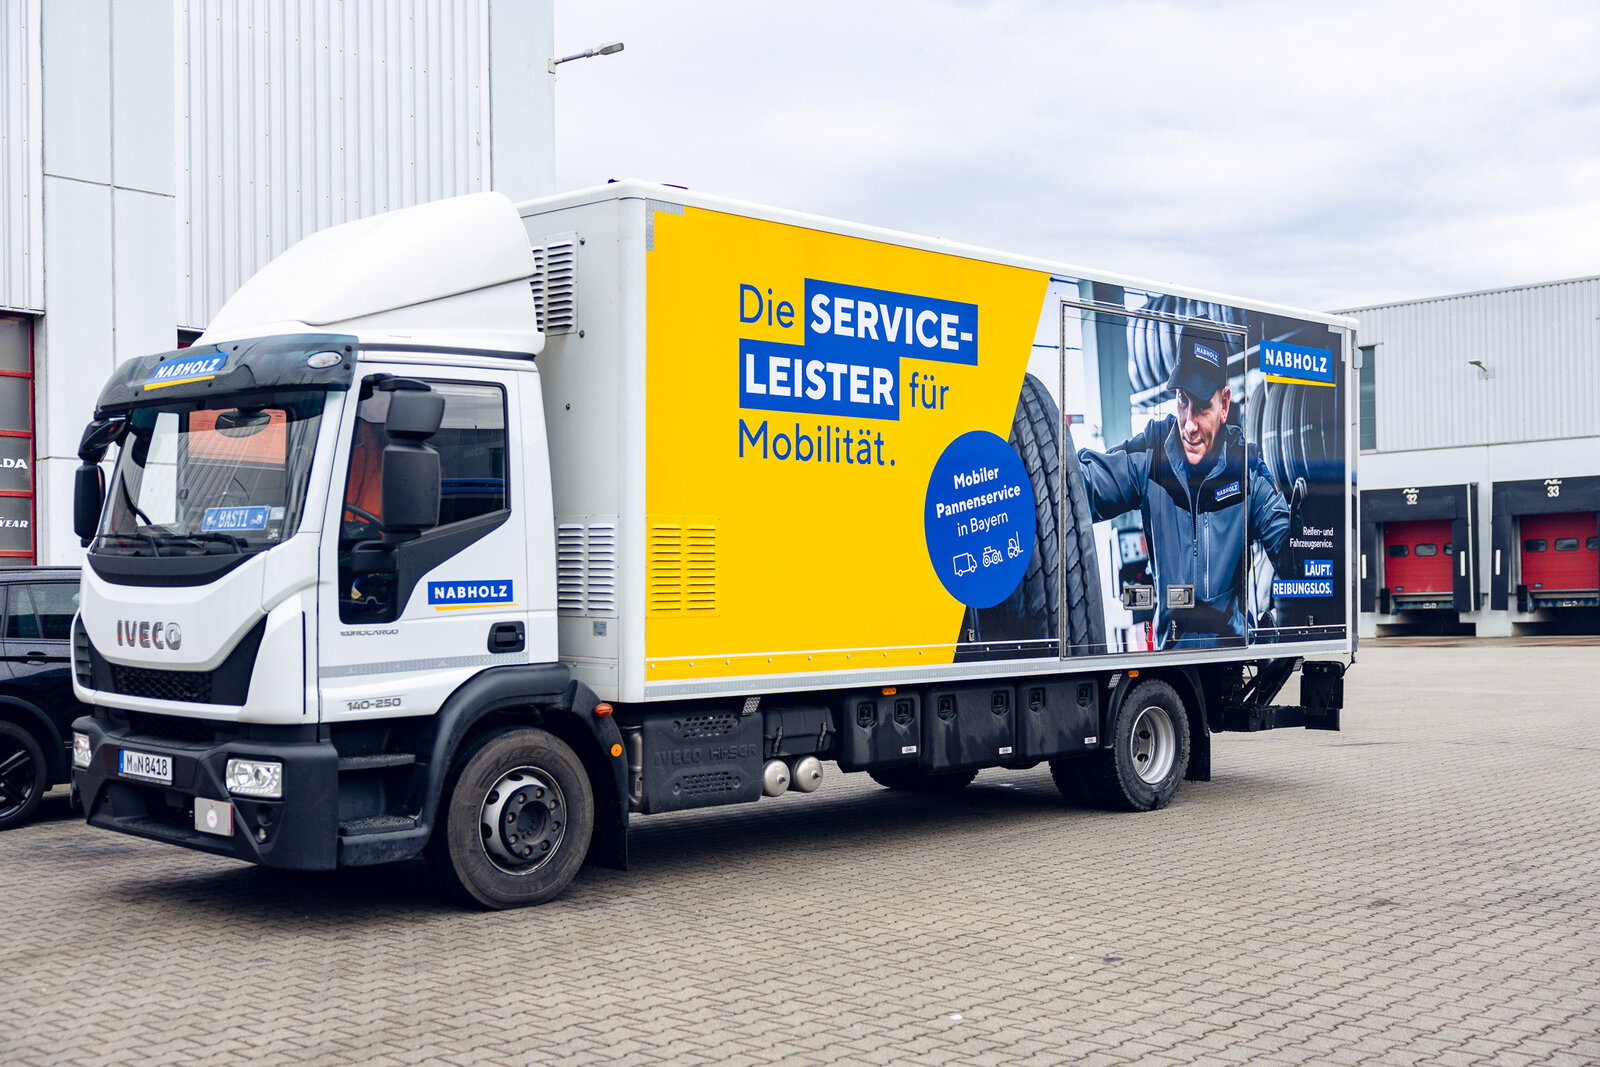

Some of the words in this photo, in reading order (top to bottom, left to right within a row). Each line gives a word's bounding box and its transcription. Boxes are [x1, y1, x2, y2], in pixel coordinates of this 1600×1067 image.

[739, 283, 795, 329] Die
[810, 293, 973, 351] SERVICE-
[1196, 346, 1218, 361] NABHOLZ
[1265, 348, 1328, 373] NABHOLZ
[154, 358, 221, 379] NABHOLZ
[745, 353, 895, 406] LEISTER
[909, 371, 950, 410] für
[738, 418, 896, 467] Mobilität.
[953, 467, 999, 490] Mobiler
[1406, 494, 1418, 505] 32
[1547, 485, 1560, 498] 33
[936, 485, 1021, 519] Pannenservice
[217, 510, 249, 528] BASTI
[957, 522, 969, 537] in
[970, 512, 1009, 533] Bayern
[1323, 527, 1334, 537] und
[1289, 538, 1334, 550] Fahrzeugservice.
[1305, 561, 1333, 576] LÄUFT.
[434, 585, 508, 599] NABHOLZ
[1273, 582, 1333, 595] REIBUNGSLOS.
[117, 619, 182, 651] IVECO
[340, 629, 399, 637] EUROCARGO
[347, 698, 402, 711] 140-250
